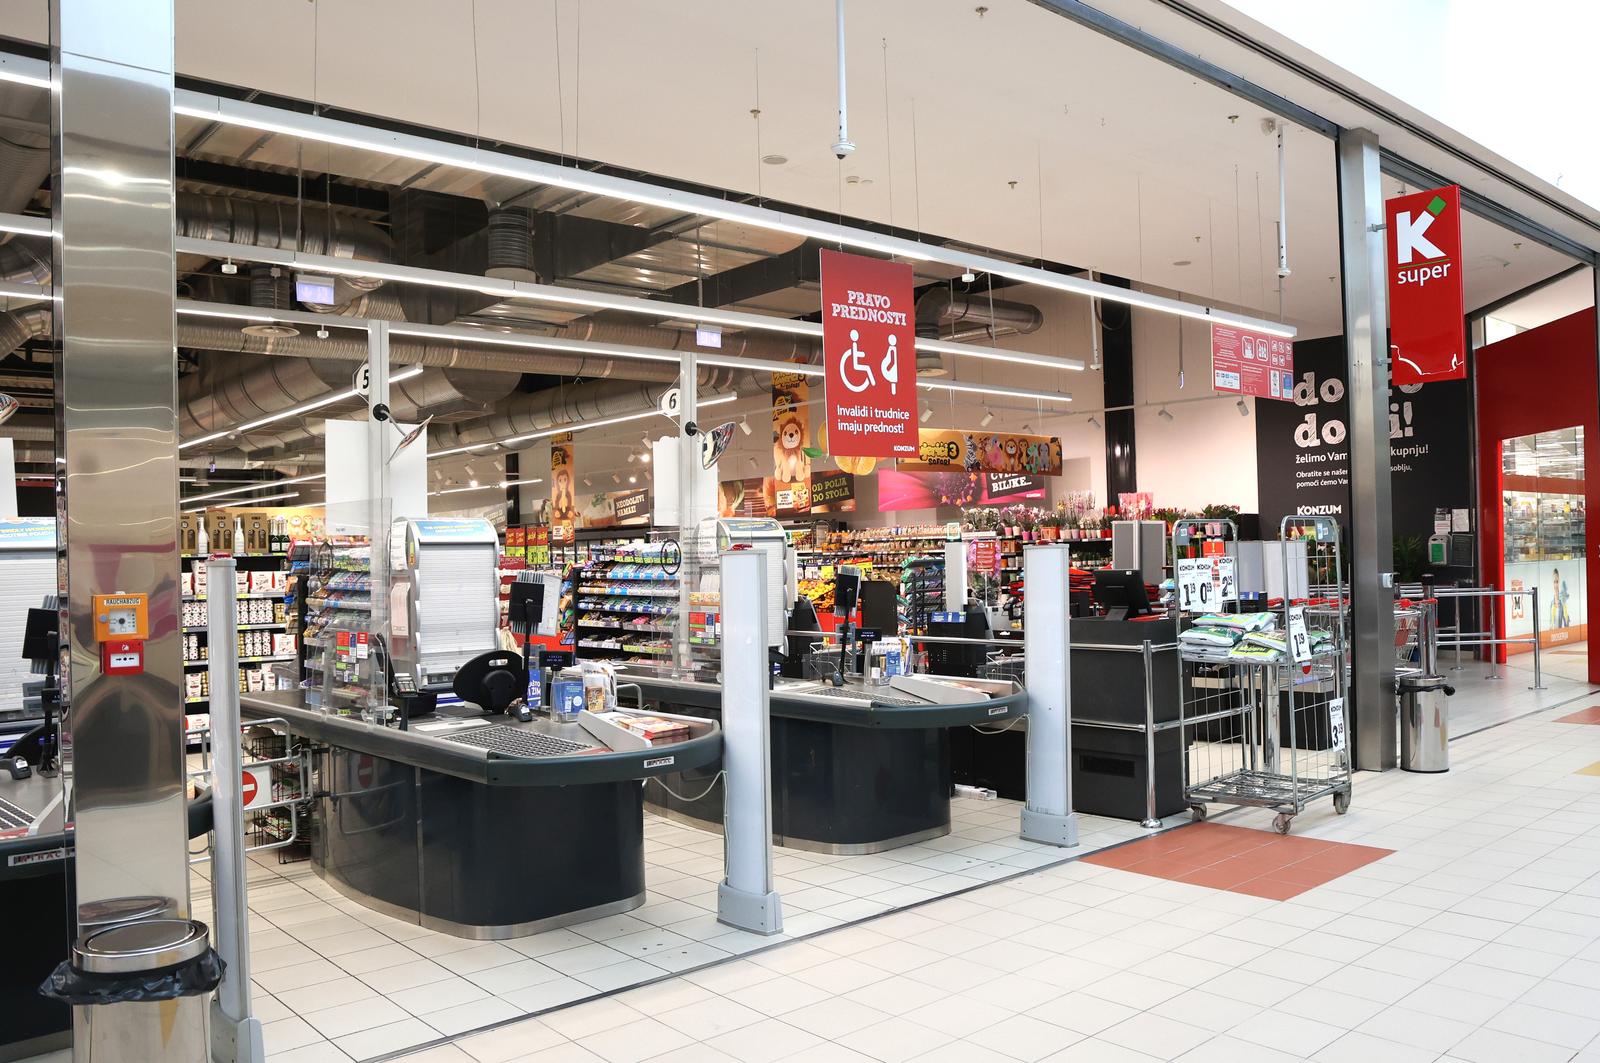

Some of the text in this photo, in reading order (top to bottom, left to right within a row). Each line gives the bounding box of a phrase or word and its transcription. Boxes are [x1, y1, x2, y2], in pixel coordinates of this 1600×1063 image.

[1396, 203, 1447, 265] K
[1397, 262, 1452, 287] super
[847, 290, 891, 309] PRAVO
[831, 303, 907, 326] PREDNOSTI
[669, 392, 677, 410] 6
[837, 403, 910, 420] Invalidi i trudnice
[837, 419, 905, 436] imaju prednost!
[1295, 453, 1326, 464] želimo
[1390, 444, 1429, 458] kupnju!
[1295, 469, 1323, 479] Obratite
[1323, 470, 1331, 478] se
[812, 481, 823, 493] OD
[1296, 479, 1319, 489] pomoći
[1320, 479, 1337, 488] ćemo
[812, 488, 850, 503] DO STOLA
[1297, 504, 1342, 516] KONZUM
[104, 598, 140, 606] RAUCHABZUG
